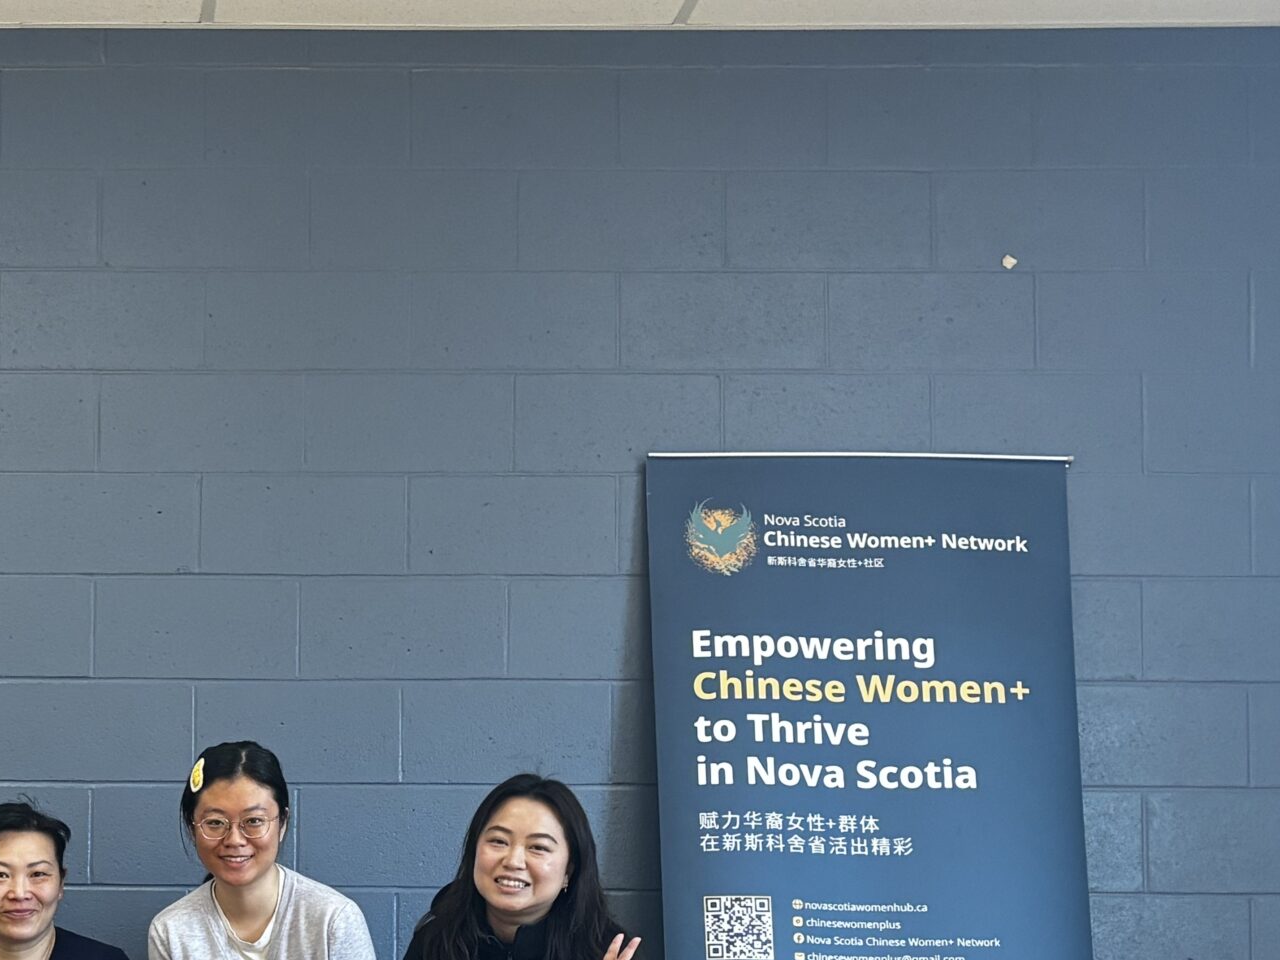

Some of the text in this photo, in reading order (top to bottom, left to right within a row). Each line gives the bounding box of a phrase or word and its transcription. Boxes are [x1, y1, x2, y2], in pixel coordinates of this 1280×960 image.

[764, 514, 846, 528] Nova Scotia
[763, 530, 1028, 552] Chinese Women+ Network
[691, 629, 936, 668] Empowering
[693, 670, 1030, 704] Chinese Women+
[694, 713, 870, 746] to Thrive
[696, 755, 978, 790] in Nova Scotia
[698, 811, 880, 834] 赋力华裔女性+群体
[699, 833, 914, 856] 在新斯科舍省活出精彩
[804, 902, 928, 912] novascotiawomenhub.ca
[806, 918, 901, 931] chinesewomenplus
[806, 935, 1001, 947] Nova Scotia Chinese Women+ Network
